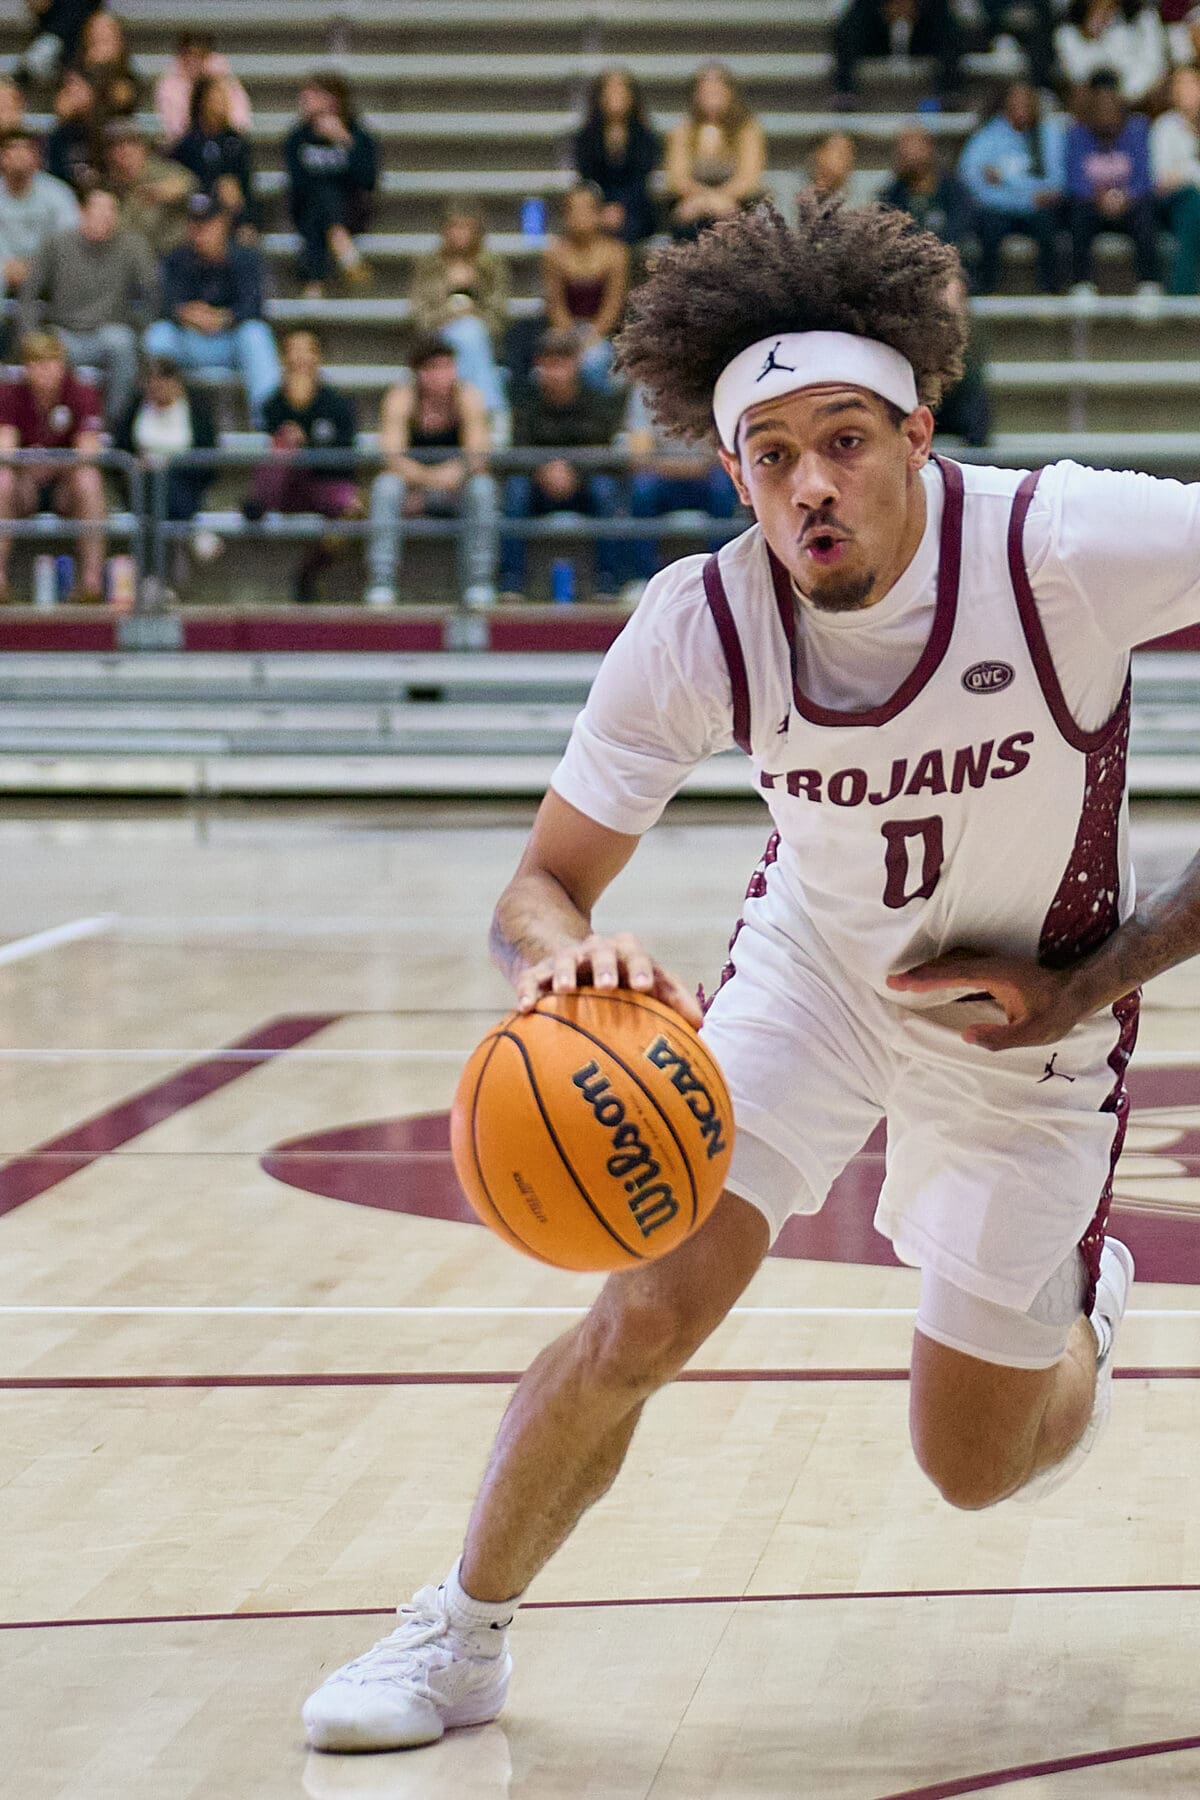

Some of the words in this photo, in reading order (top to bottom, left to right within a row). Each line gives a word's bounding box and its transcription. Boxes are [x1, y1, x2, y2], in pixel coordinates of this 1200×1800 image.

[881, 815, 944, 910] 0
[572, 1059, 681, 1239] Wilson
[643, 1034, 726, 1161] NCAA
